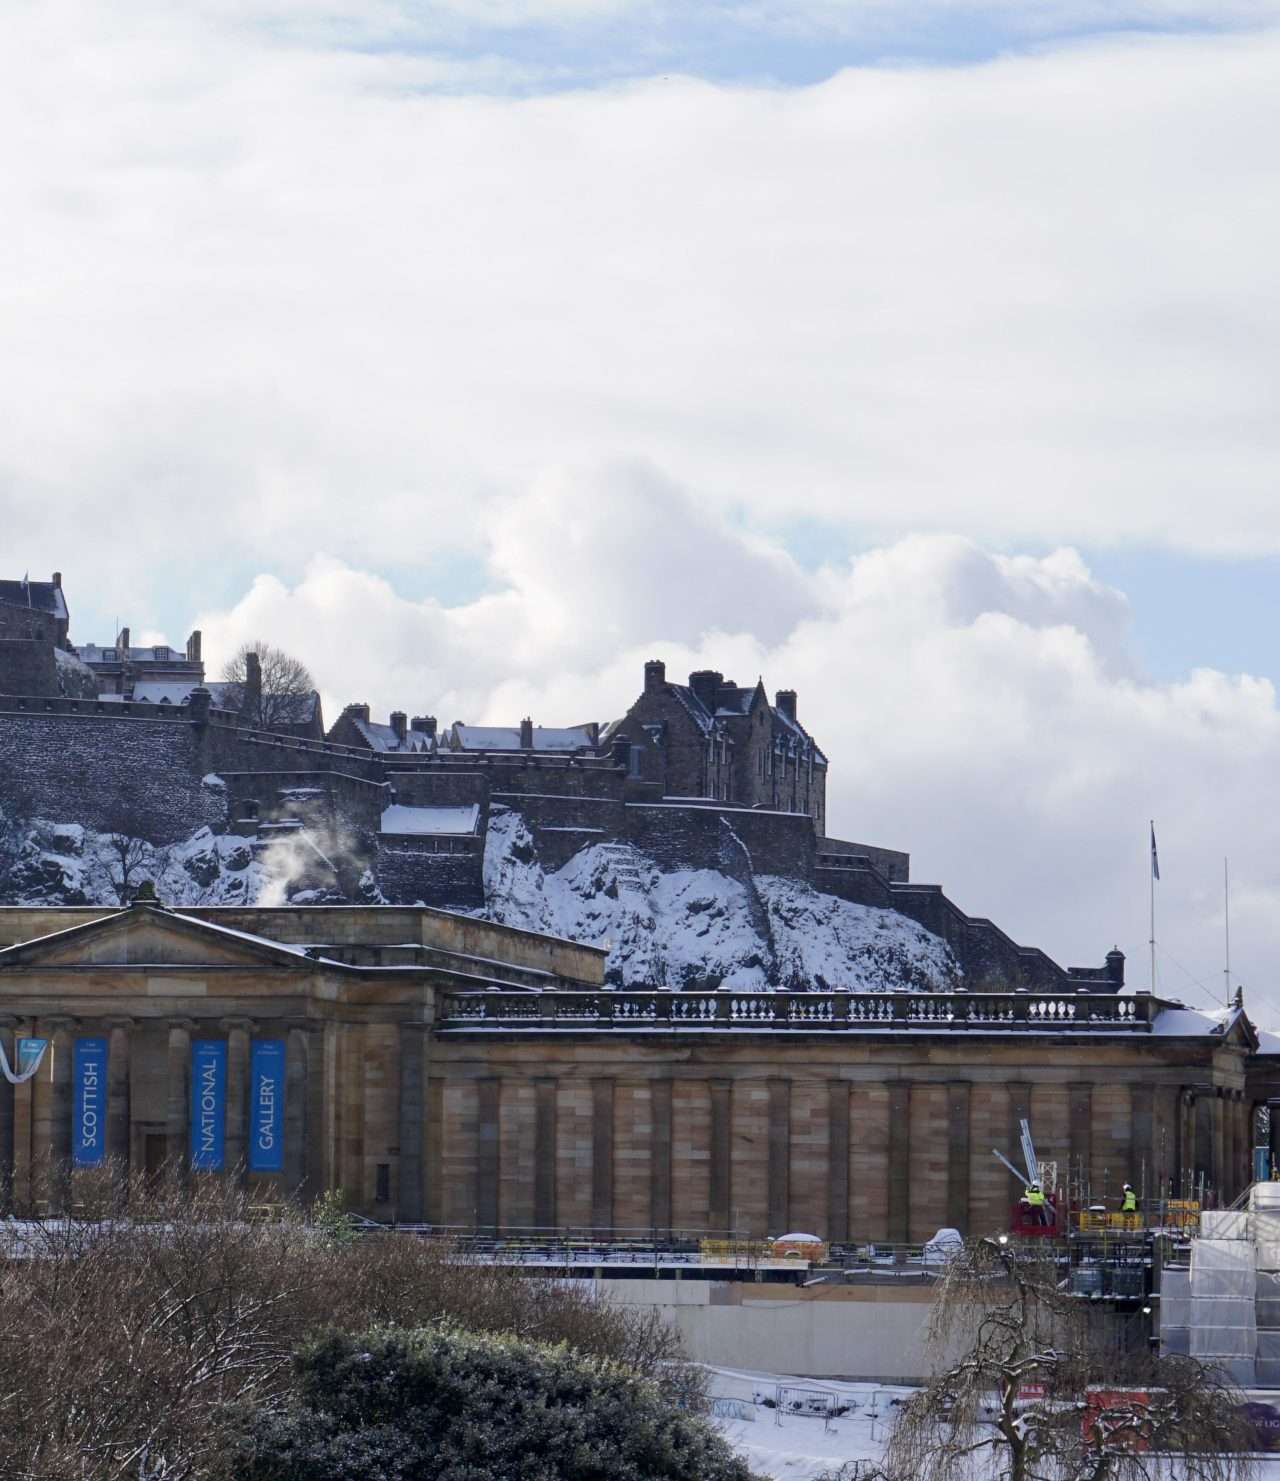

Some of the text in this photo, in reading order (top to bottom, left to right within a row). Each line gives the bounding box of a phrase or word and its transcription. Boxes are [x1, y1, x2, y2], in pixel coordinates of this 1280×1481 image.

[82, 1063, 98, 1148] SCOTTISH
[201, 1059, 216, 1151] NATIONAL
[259, 1075, 275, 1150] GALLERY
